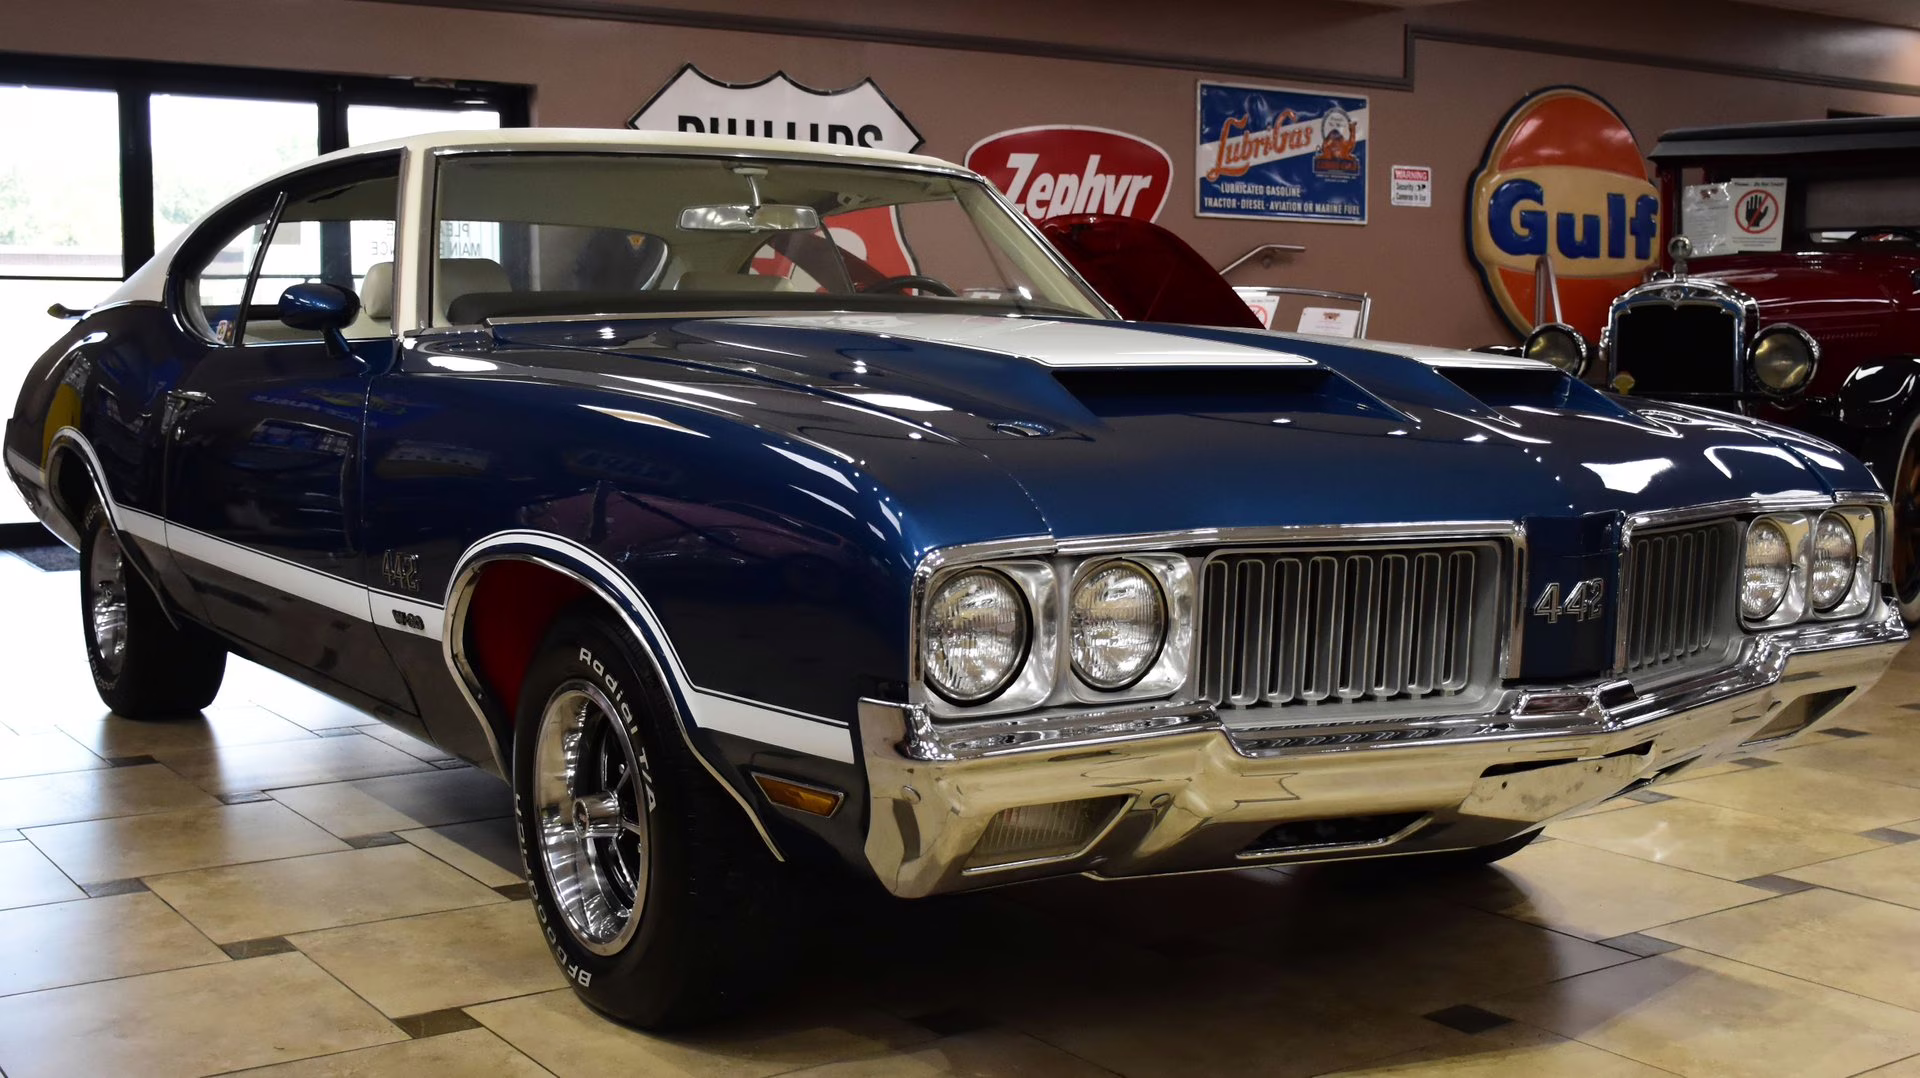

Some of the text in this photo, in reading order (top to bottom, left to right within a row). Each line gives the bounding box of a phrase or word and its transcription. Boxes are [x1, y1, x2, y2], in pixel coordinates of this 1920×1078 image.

[1006, 153, 1153, 220] Zephyr
[1204, 197, 1360, 215] TRACTOR DIESEL AVIATION OR MARINE FUEL
[1220, 182, 1301, 198] LUBRICATED GASOLINE
[1488, 178, 1659, 261] Gulf
[1533, 578, 1604, 623] 442
[579, 647, 656, 813] Radial T/A
